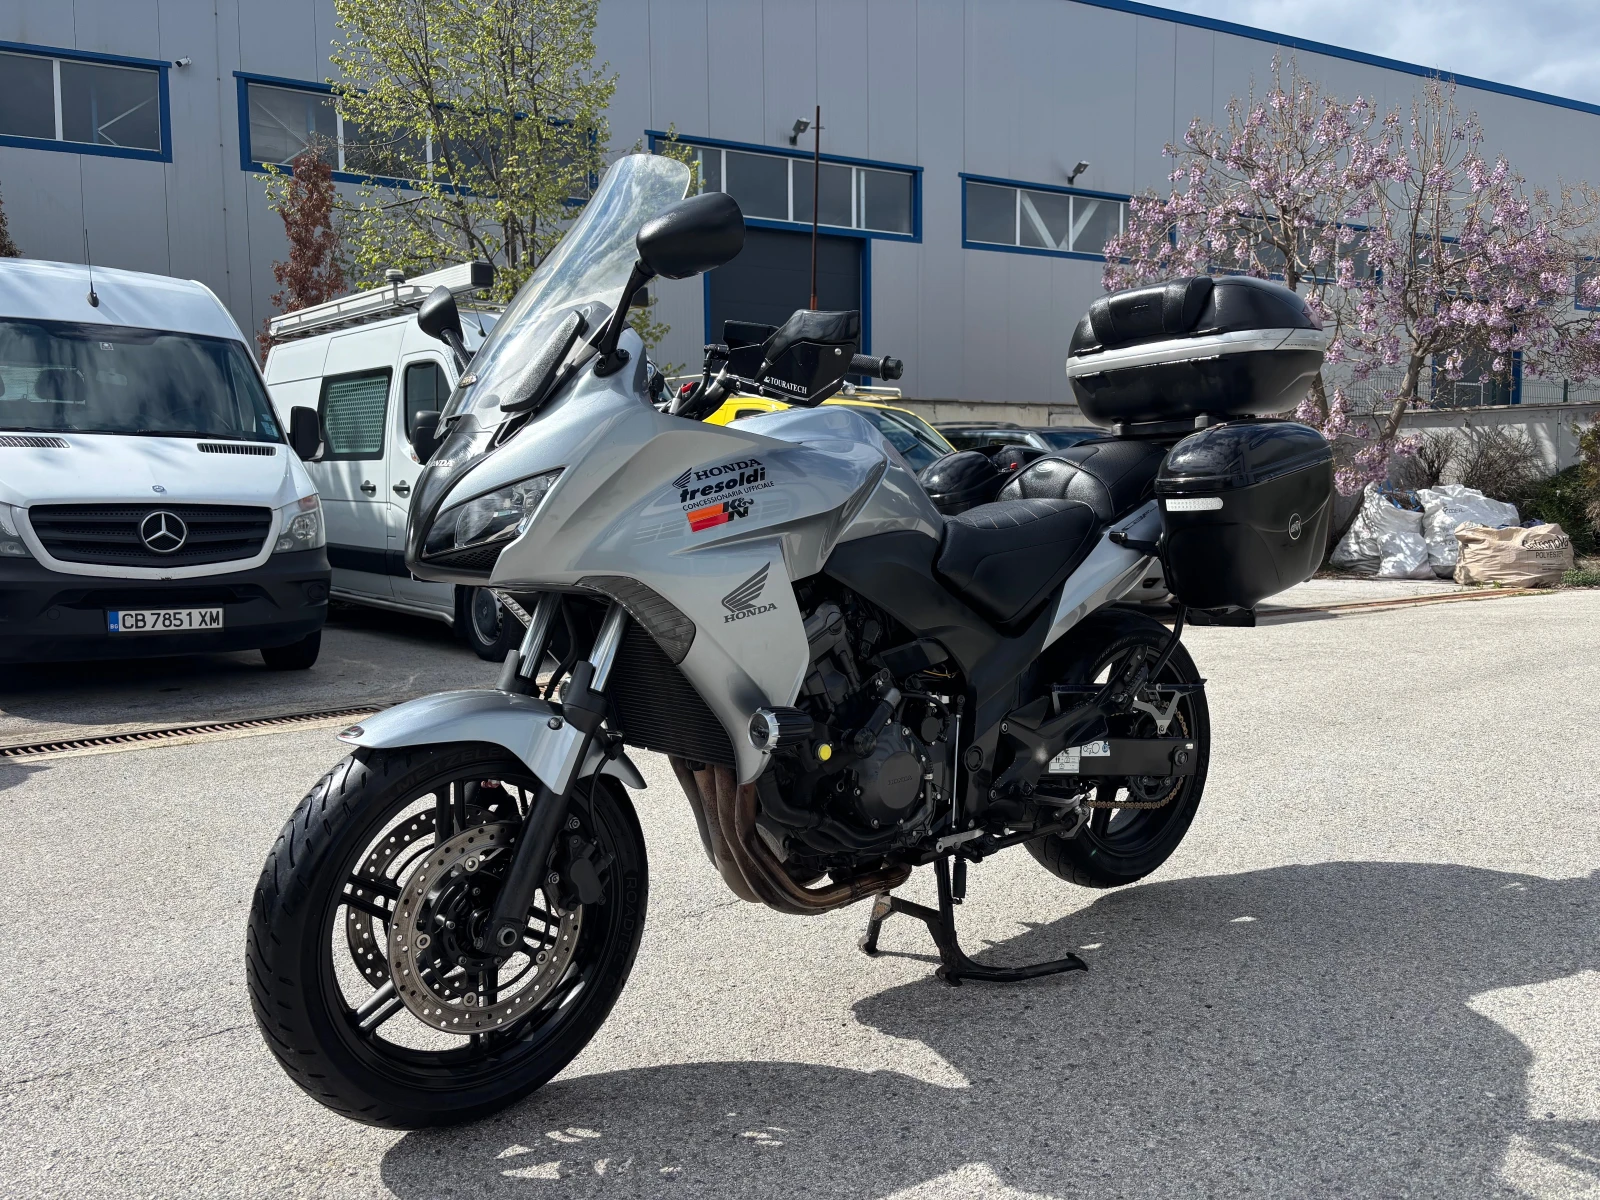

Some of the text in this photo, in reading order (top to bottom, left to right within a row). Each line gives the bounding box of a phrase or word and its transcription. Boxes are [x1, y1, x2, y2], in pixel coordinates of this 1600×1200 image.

[770, 377, 807, 395] TOURATECH
[694, 458, 763, 481] HONDA
[679, 467, 766, 503] tresoldi
[682, 481, 774, 512] CONCESSIONARIA UFFICIALE
[122, 610, 220, 629] CB 7851 XM
[723, 602, 778, 624] HONDA
[613, 876, 638, 967] ROADTEC
